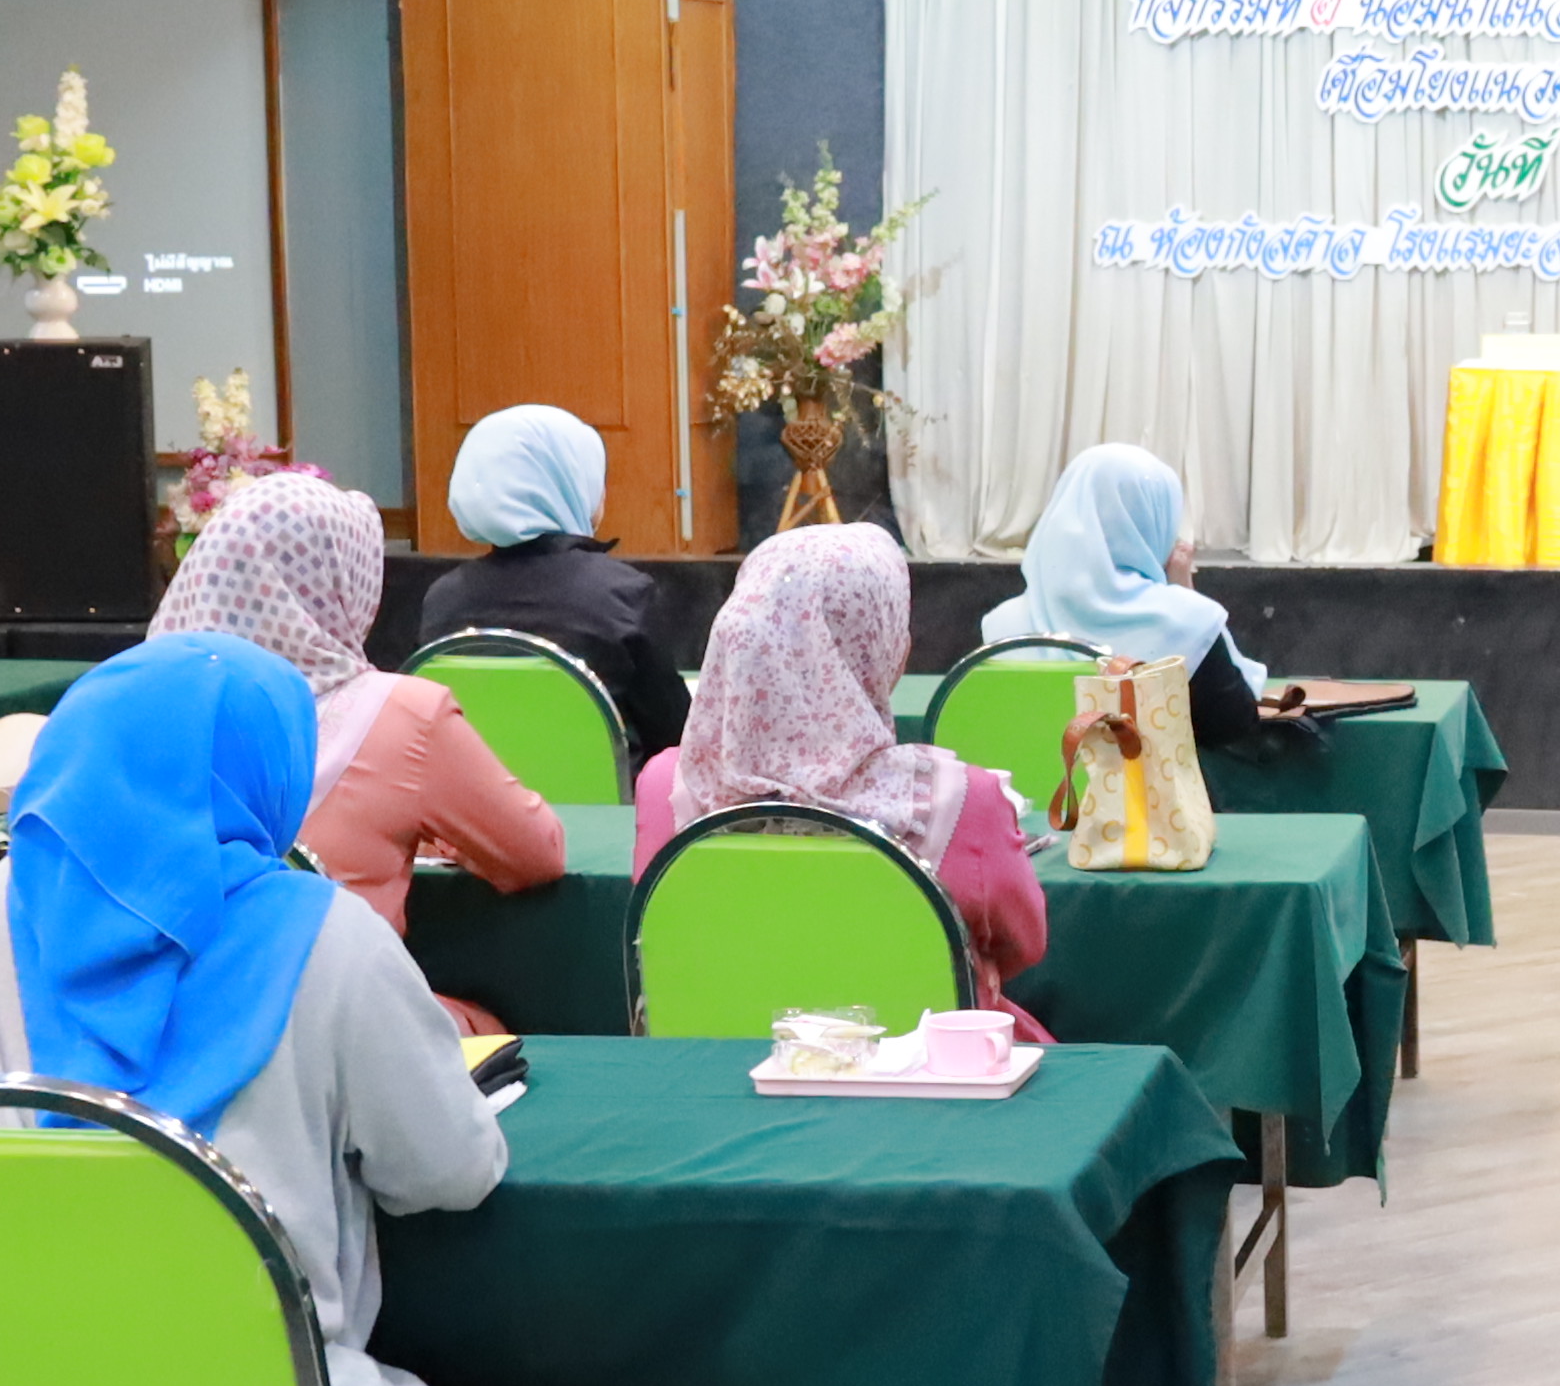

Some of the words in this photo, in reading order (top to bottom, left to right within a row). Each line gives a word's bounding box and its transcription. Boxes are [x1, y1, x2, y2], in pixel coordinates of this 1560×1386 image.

[1439, 127, 1560, 208] วันที่
[1097, 224, 1135, 261] ณ
